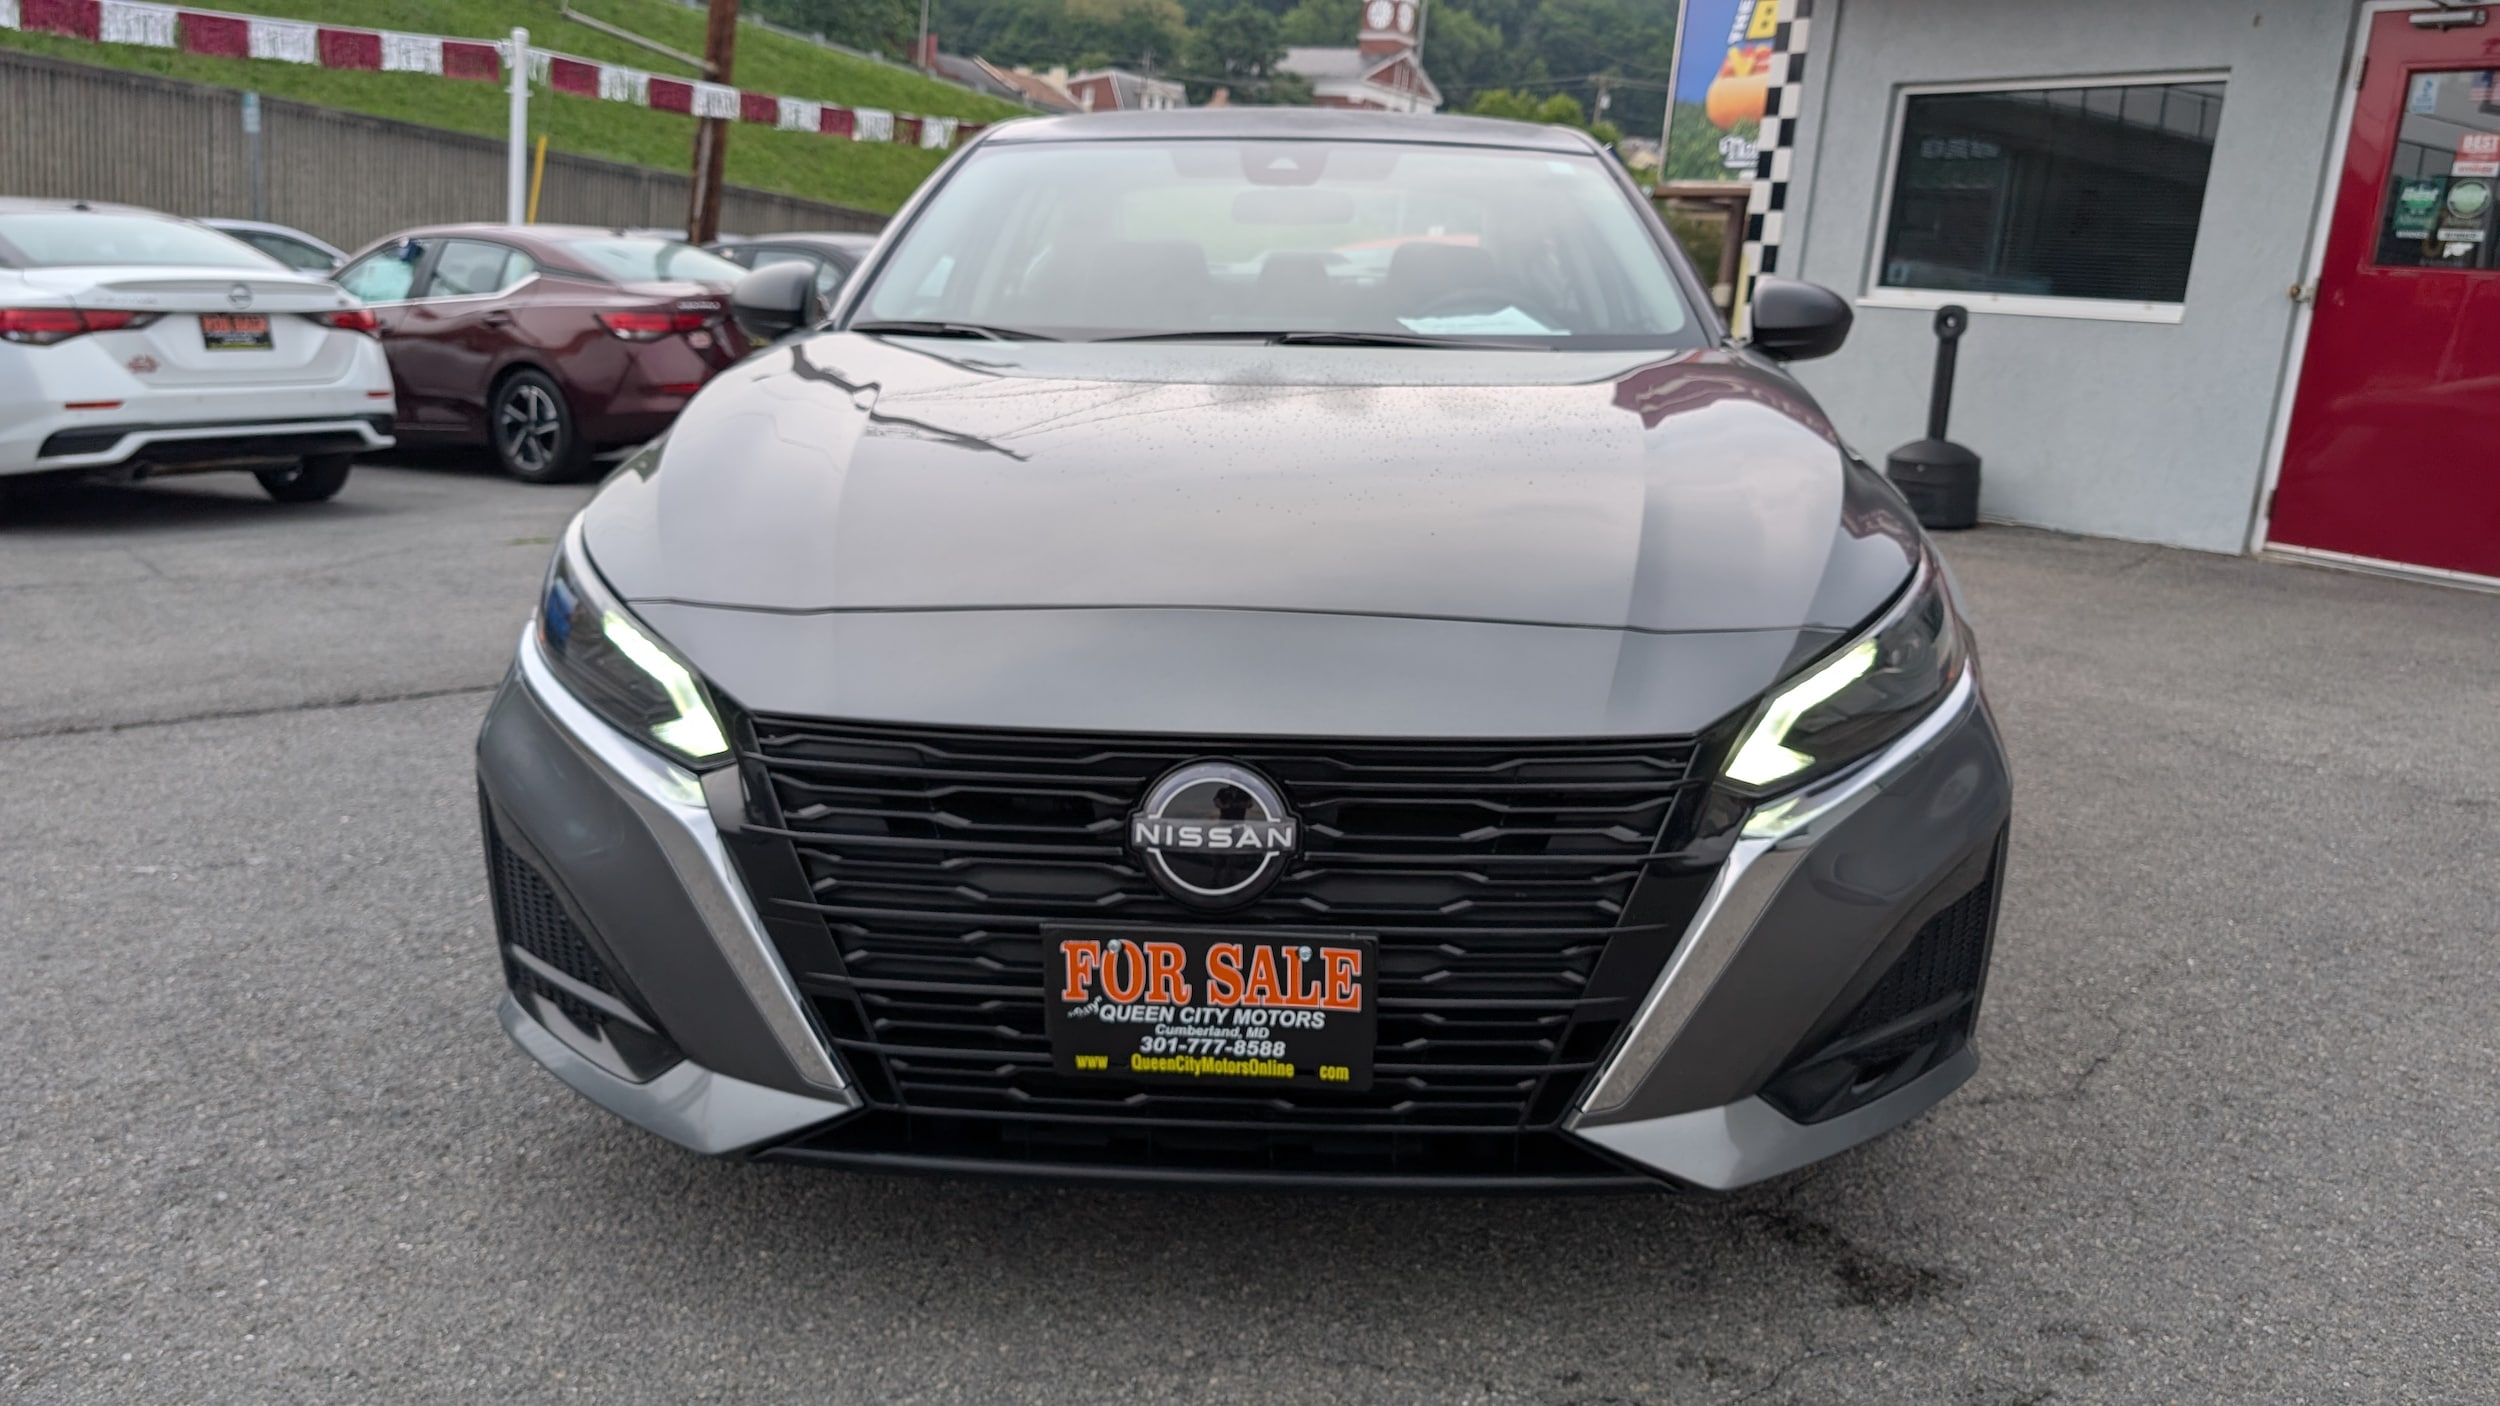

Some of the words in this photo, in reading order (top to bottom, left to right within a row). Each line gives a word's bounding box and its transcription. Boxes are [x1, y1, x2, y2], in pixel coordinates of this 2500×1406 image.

[1135, 822, 1292, 848] NISSAN
[1060, 939, 1192, 1006] FOR
[1206, 943, 1362, 1013] SALE
[1100, 1004, 1175, 1024] QUEEN
[1179, 1006, 1230, 1026] CITY
[1232, 1009, 1326, 1031] MOTORS
[1155, 1023, 1243, 1040] Cumberland,
[1246, 1027, 1270, 1040] MD
[1139, 1035, 1286, 1059] 301-777-8588
[1075, 1055, 1109, 1071] www
[1131, 1053, 1295, 1079] QueenCityMotorsOnline
[1319, 1065, 1349, 1082] com
